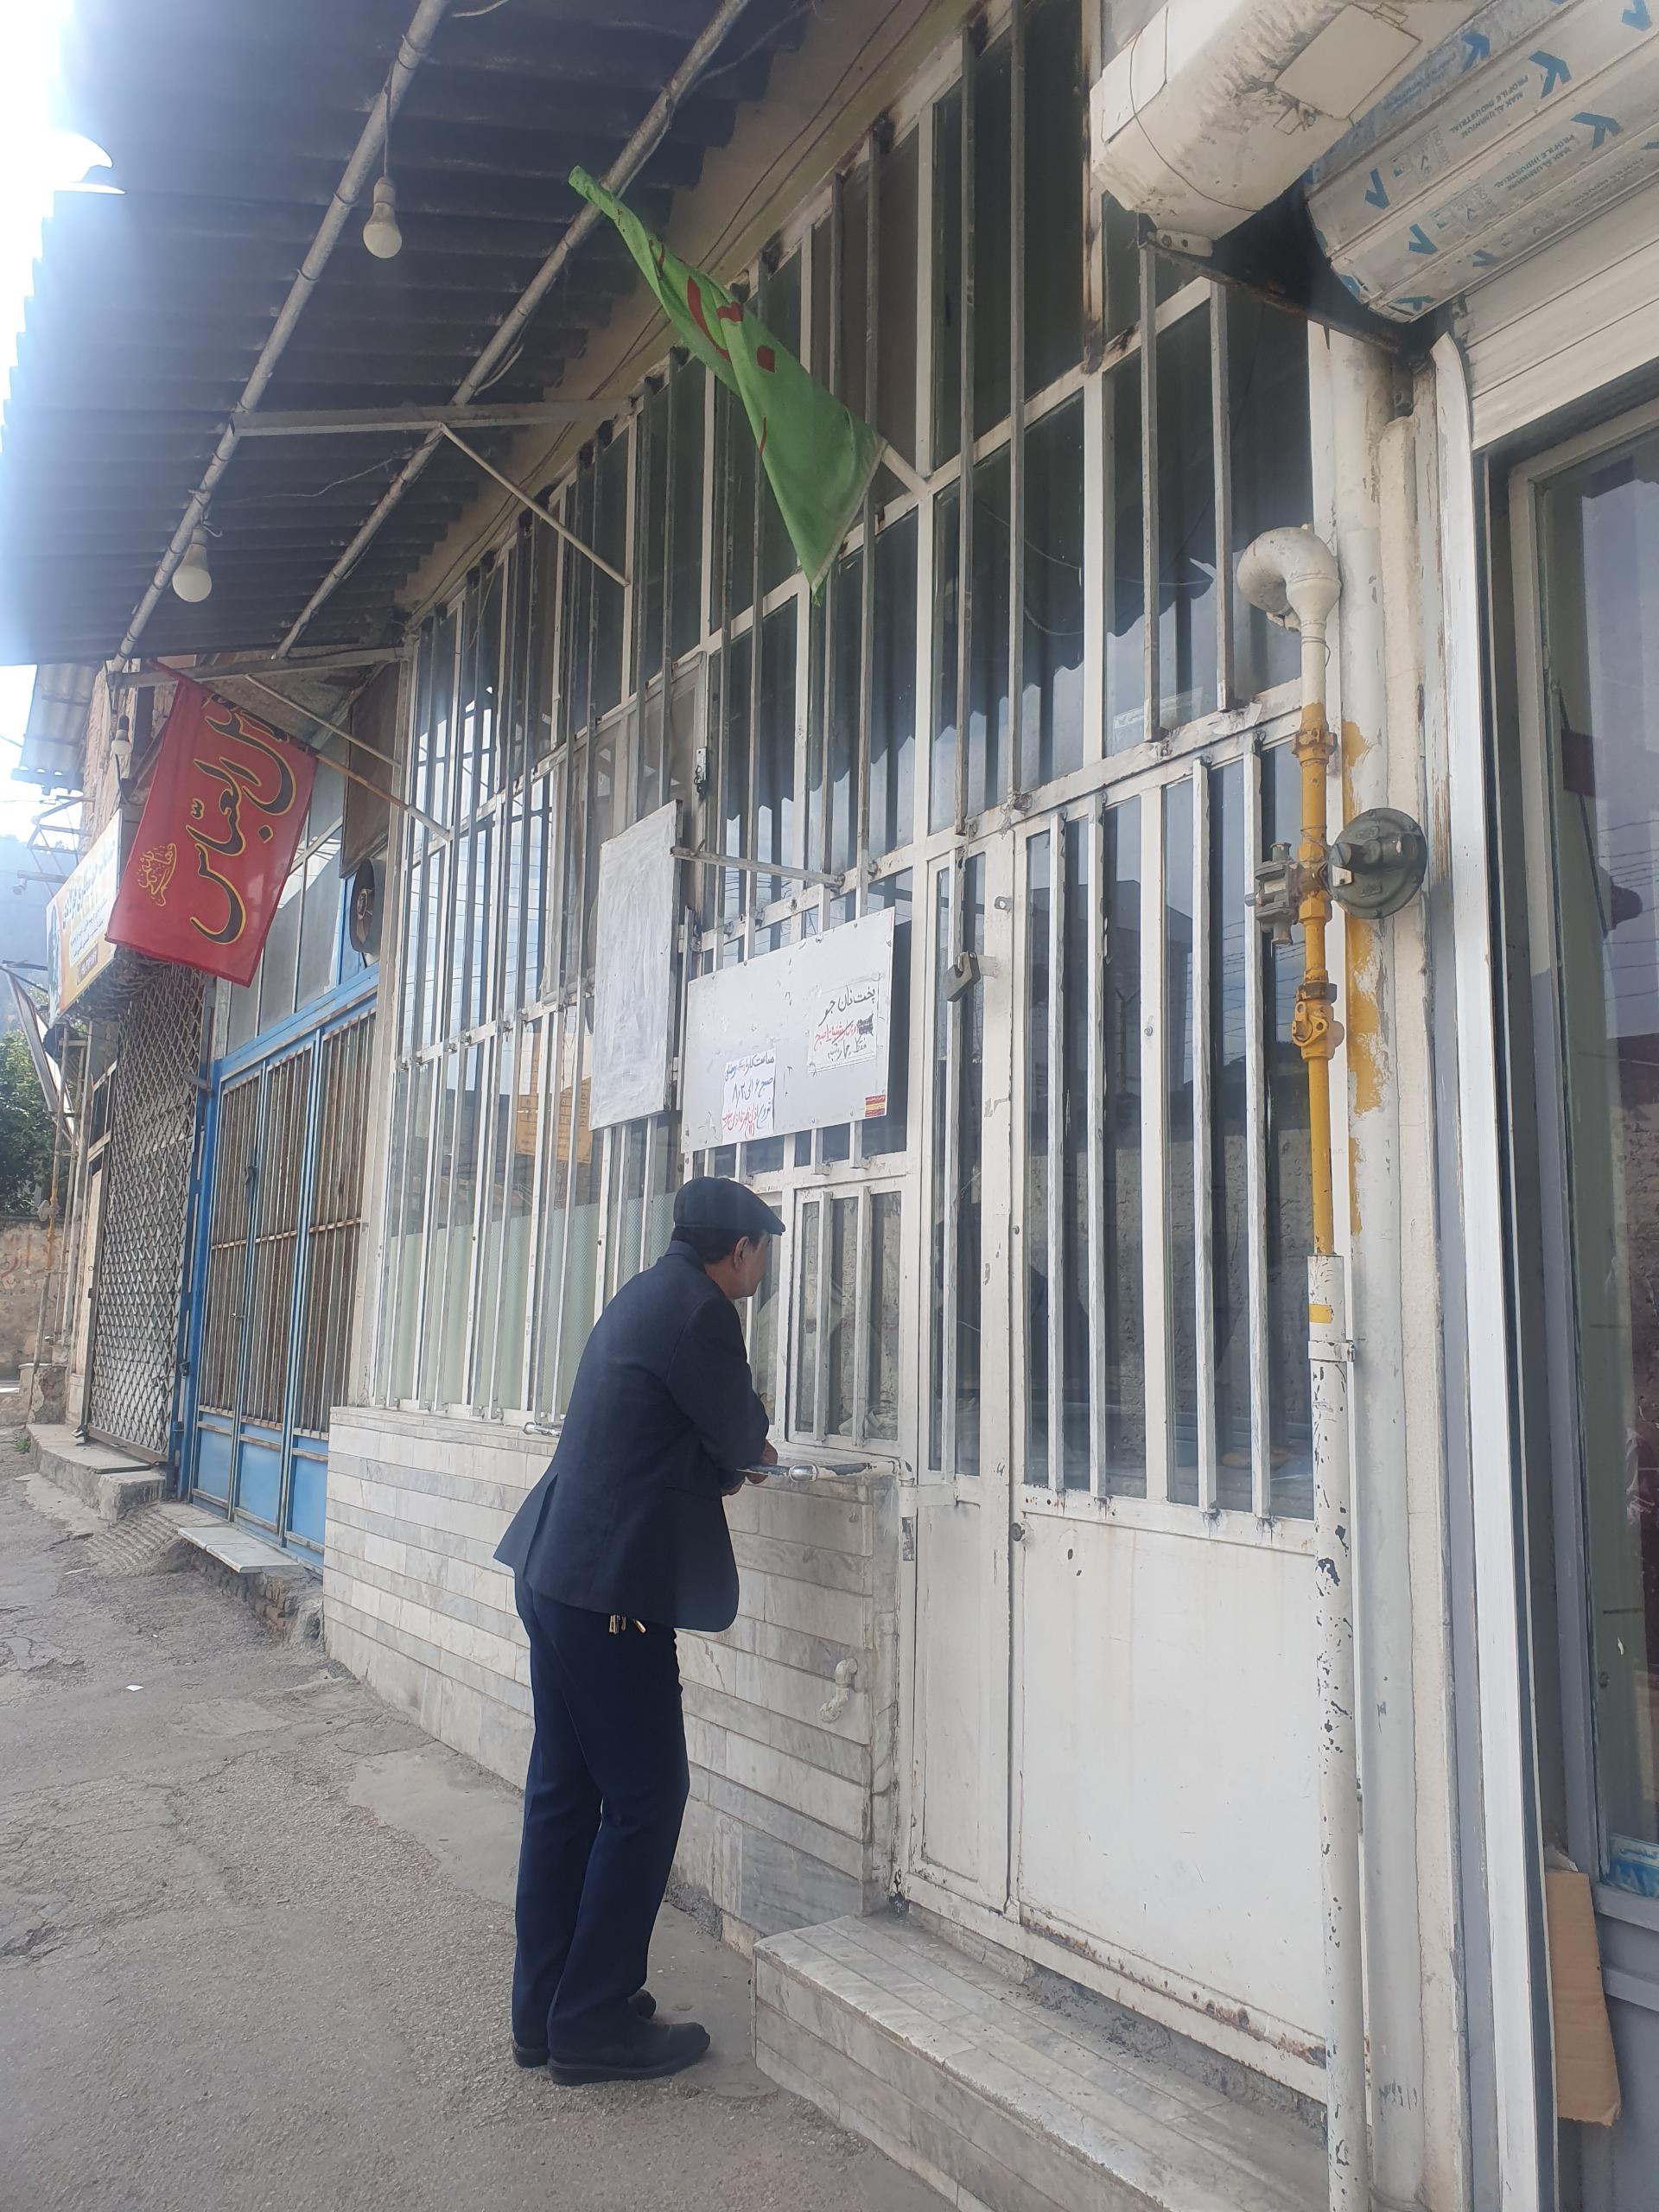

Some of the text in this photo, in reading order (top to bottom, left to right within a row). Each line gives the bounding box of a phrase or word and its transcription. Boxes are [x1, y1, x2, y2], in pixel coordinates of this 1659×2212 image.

[1496, 75, 1529, 101] PROFILE
[1449, 99, 1495, 133] INDUSTRIAL
[818, 985, 875, 1027] پخت نان جو
[754, 1052, 774, 1067] ساعت
[758, 1077, 773, 1097] صبح
